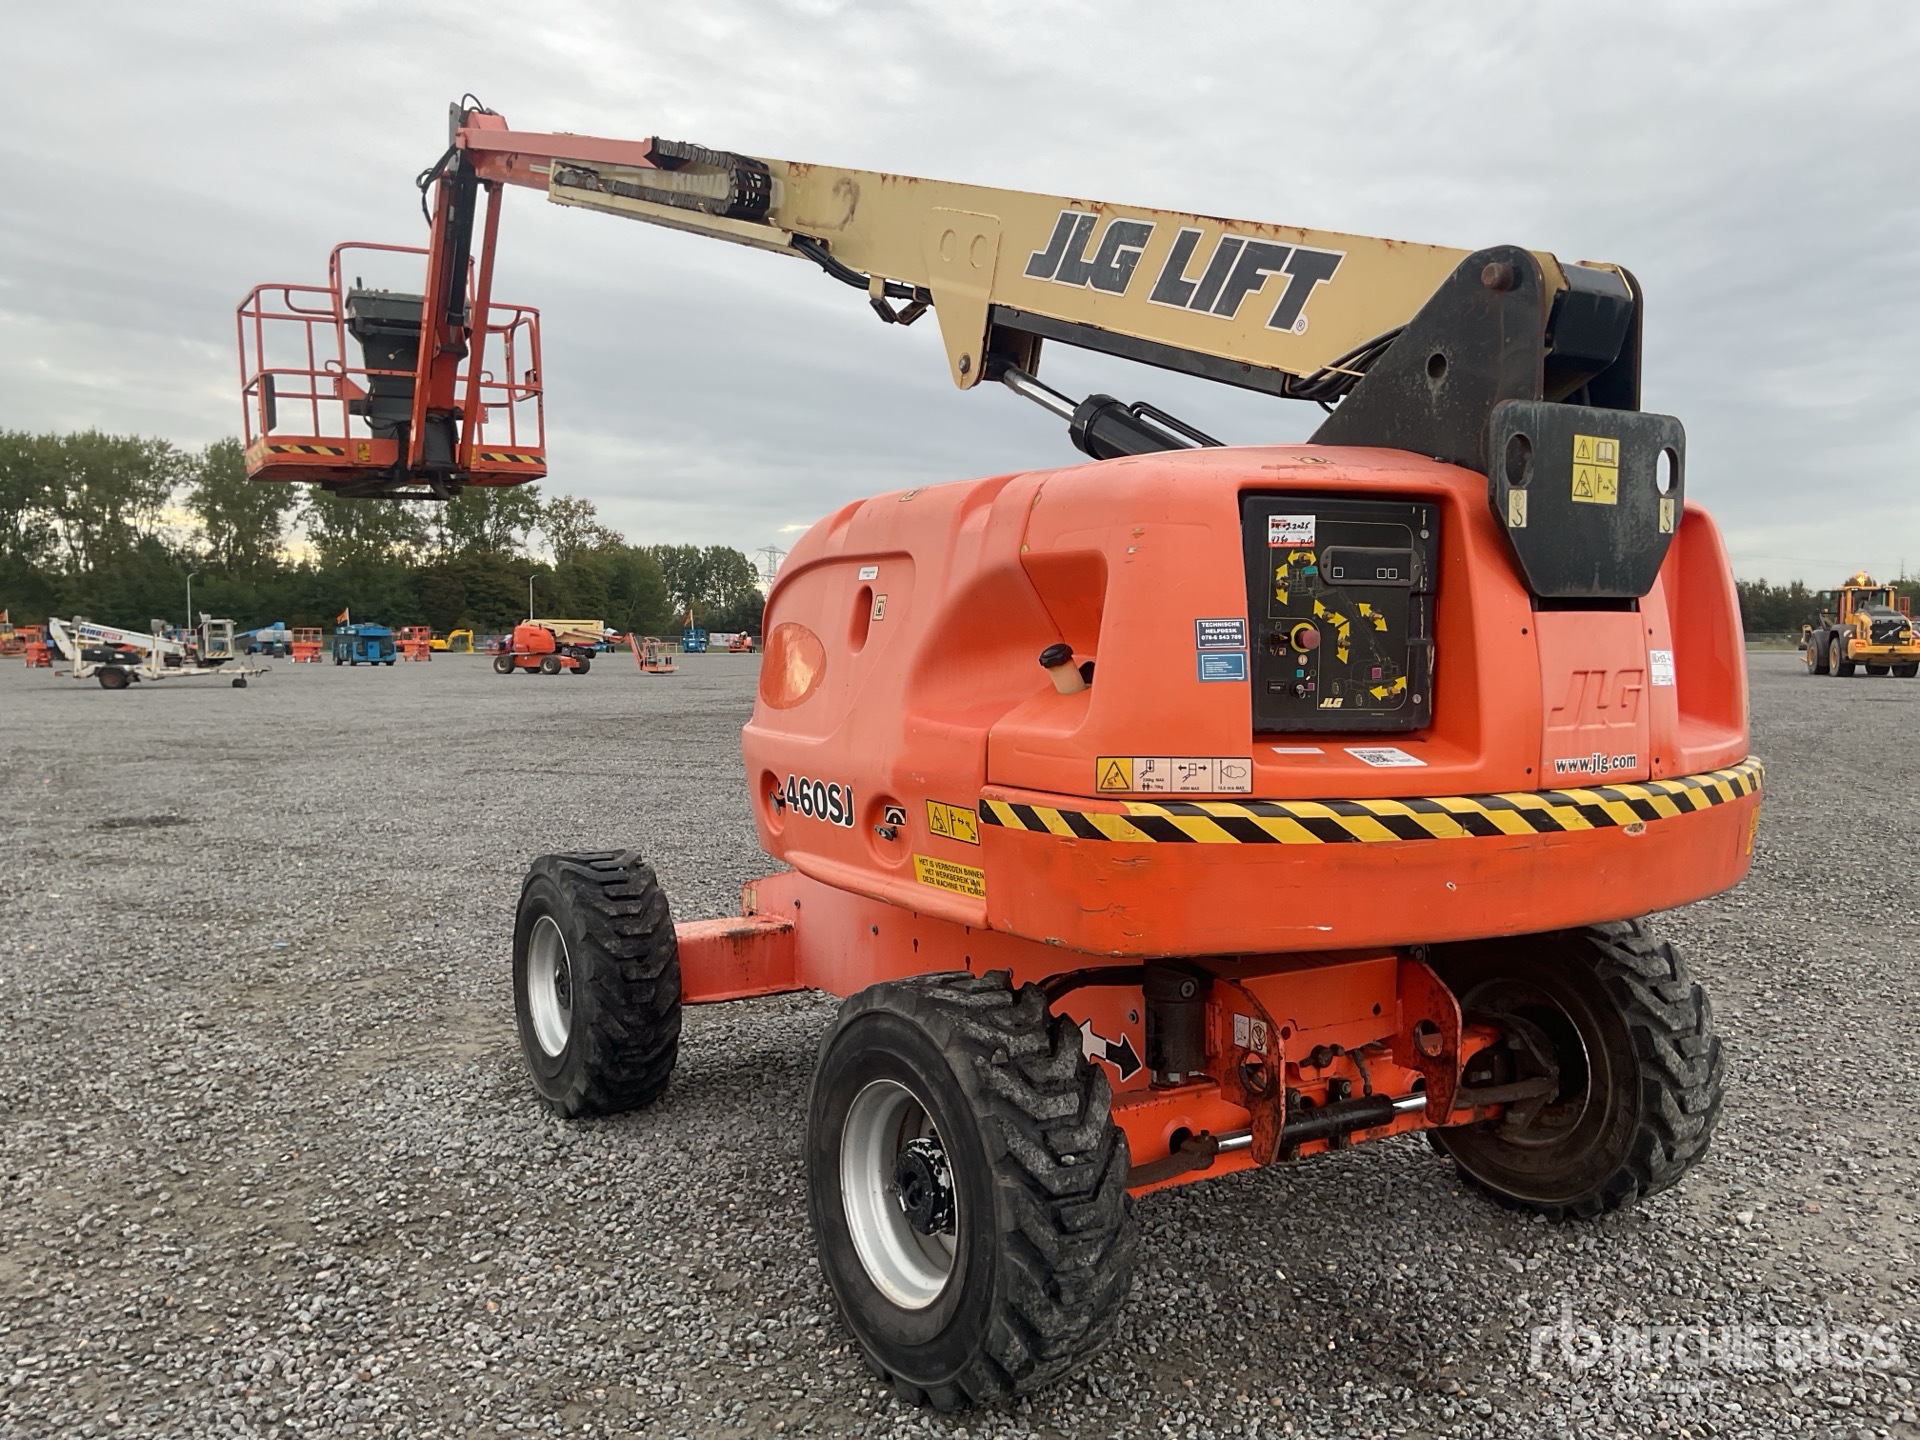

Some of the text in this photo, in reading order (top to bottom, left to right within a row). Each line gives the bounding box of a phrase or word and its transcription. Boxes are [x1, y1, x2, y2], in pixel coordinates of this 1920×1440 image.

[1022, 209, 1157, 297] JLG
[1320, 697, 1343, 708] JLG
[1546, 668, 1644, 731] JLG
[1555, 753, 1637, 774] www.jlg.com
[786, 774, 854, 828] 460SJ
[918, 858, 928, 866] HET
[935, 862, 962, 874] VERBODEN
[964, 868, 984, 879] BINNEN
[922, 875, 934, 884] DEZE
[936, 879, 958, 890] MACHINE
[959, 884, 967, 893] TE
